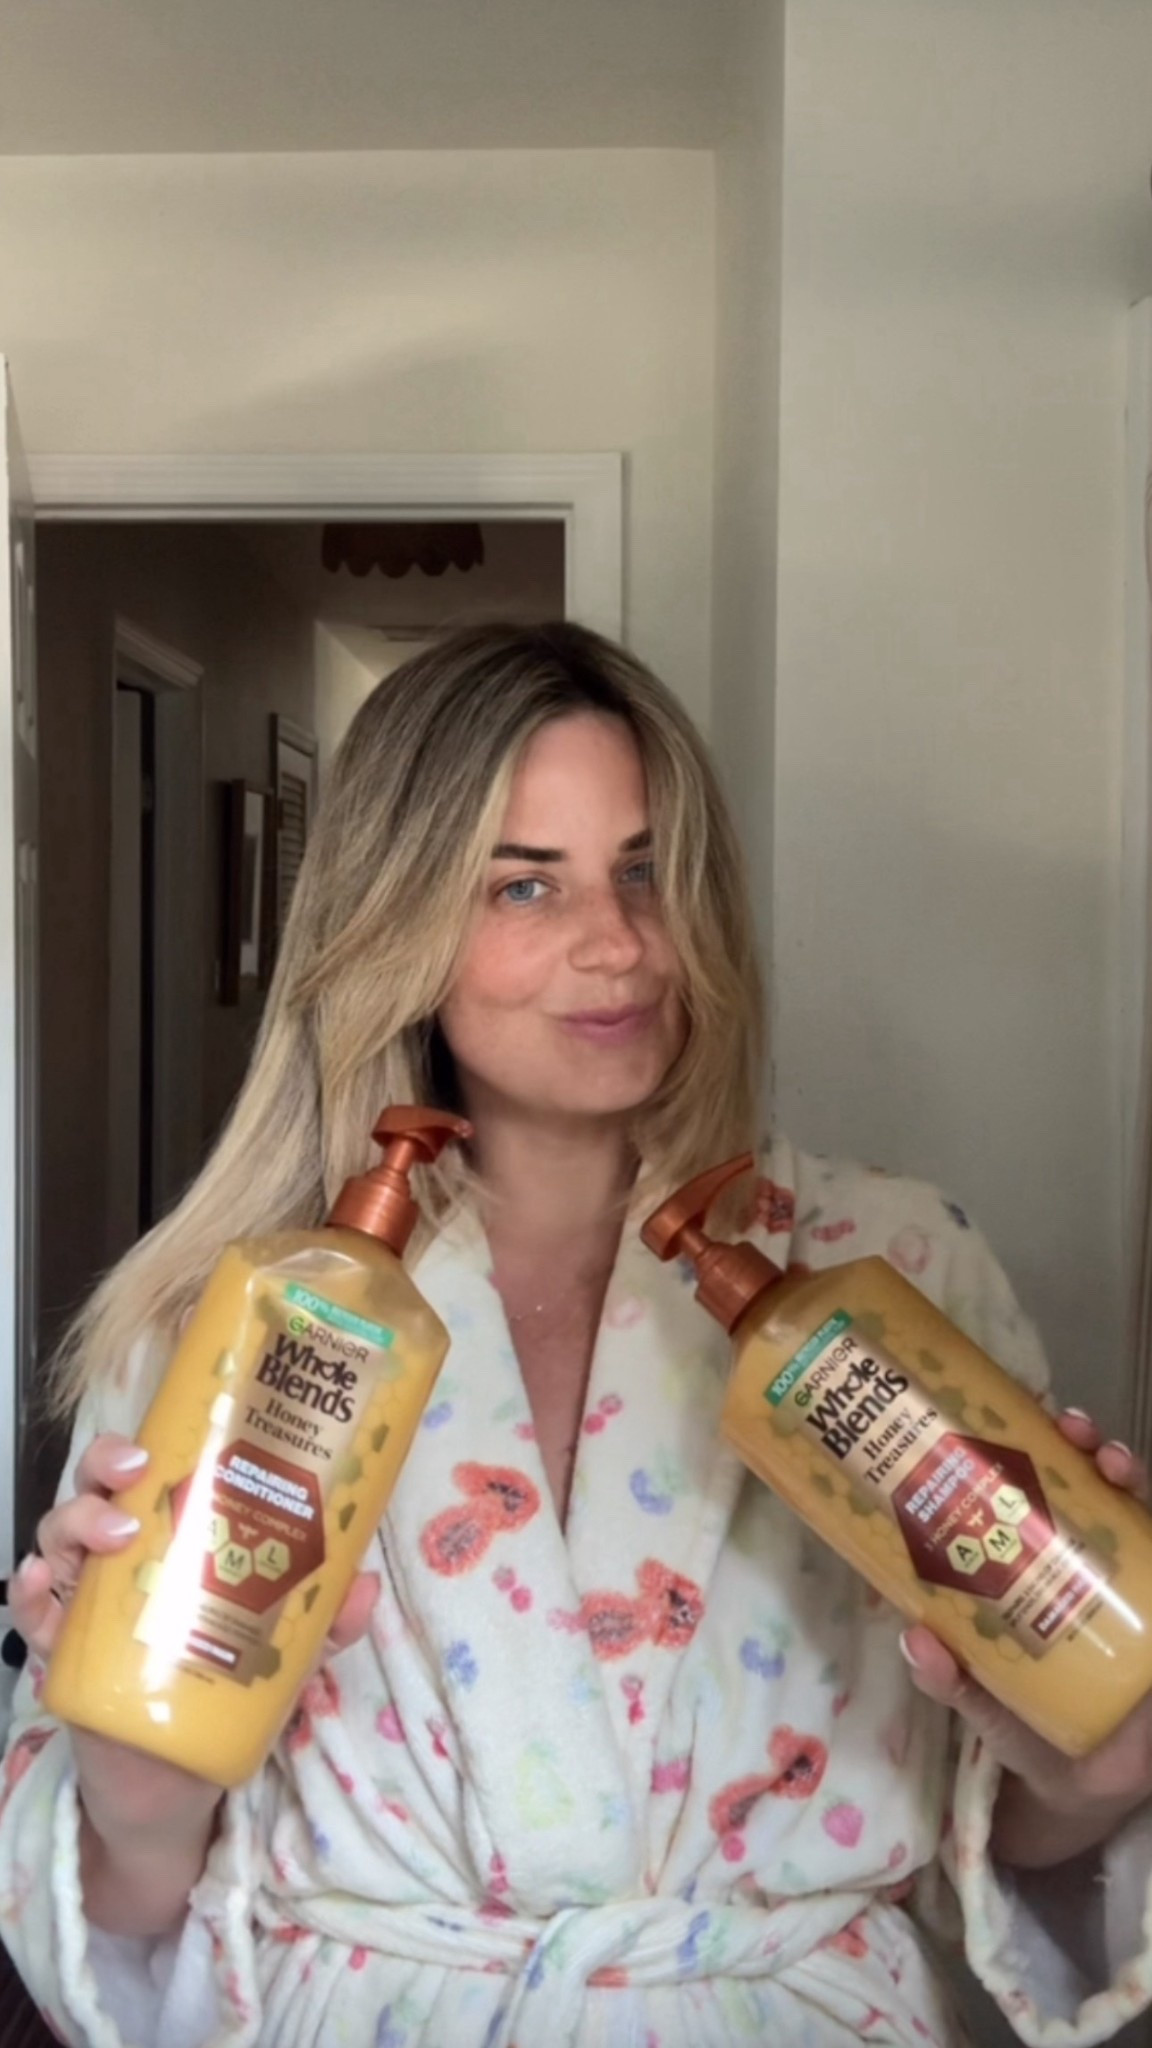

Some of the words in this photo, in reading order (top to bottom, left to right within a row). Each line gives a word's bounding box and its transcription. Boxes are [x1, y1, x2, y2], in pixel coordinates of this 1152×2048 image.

[274, 1333, 357, 1390] Whole
[289, 1316, 369, 1363] GARNIER
[256, 1353, 355, 1423] Blends
[795, 1336, 858, 1407] GARNIER
[805, 1357, 880, 1433] Whole
[245, 1405, 331, 1460] Treasures
[265, 1398, 320, 1436] Honey
[821, 1369, 909, 1460] Blends
[862, 1407, 912, 1461] Honey
[865, 1408, 938, 1485] Treasures
[214, 1465, 315, 1521] CONDITIONER
[229, 1455, 308, 1501] REPAIRING
[905, 1446, 967, 1515] REPAIRING
[917, 1458, 976, 1524] SHAMPOO
[998, 1495, 1017, 1510] L
[931, 1506, 962, 1546] HONEY
[955, 1544, 972, 1561] A
[988, 1529, 1010, 1552] M
[225, 1549, 245, 1569] M
[266, 1545, 278, 1564] L
